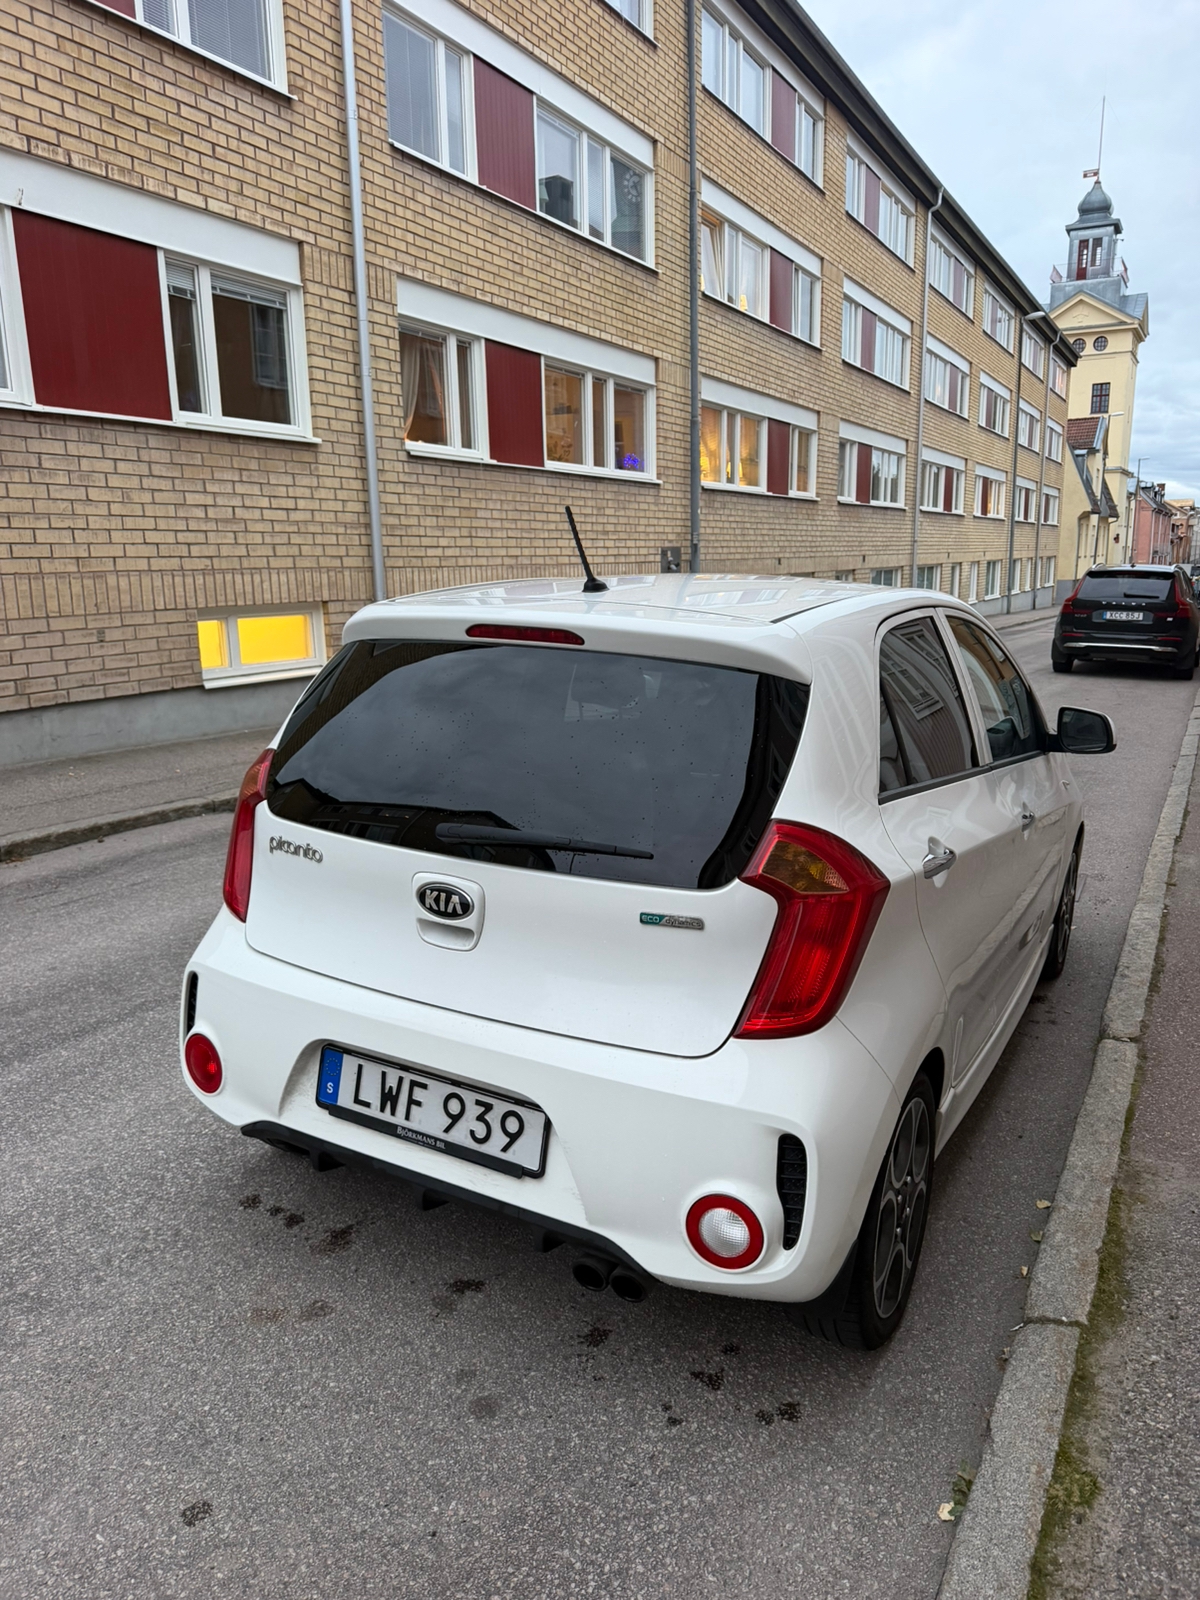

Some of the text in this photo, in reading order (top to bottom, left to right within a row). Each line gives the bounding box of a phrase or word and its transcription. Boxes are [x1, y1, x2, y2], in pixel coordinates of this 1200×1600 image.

[1109, 611, 1124, 619] XCC
[269, 836, 323, 863] picanto
[424, 889, 463, 915] KIA
[326, 1082, 334, 1094] S
[353, 1063, 525, 1153] LWF 939
[436, 1140, 446, 1149] BIL
